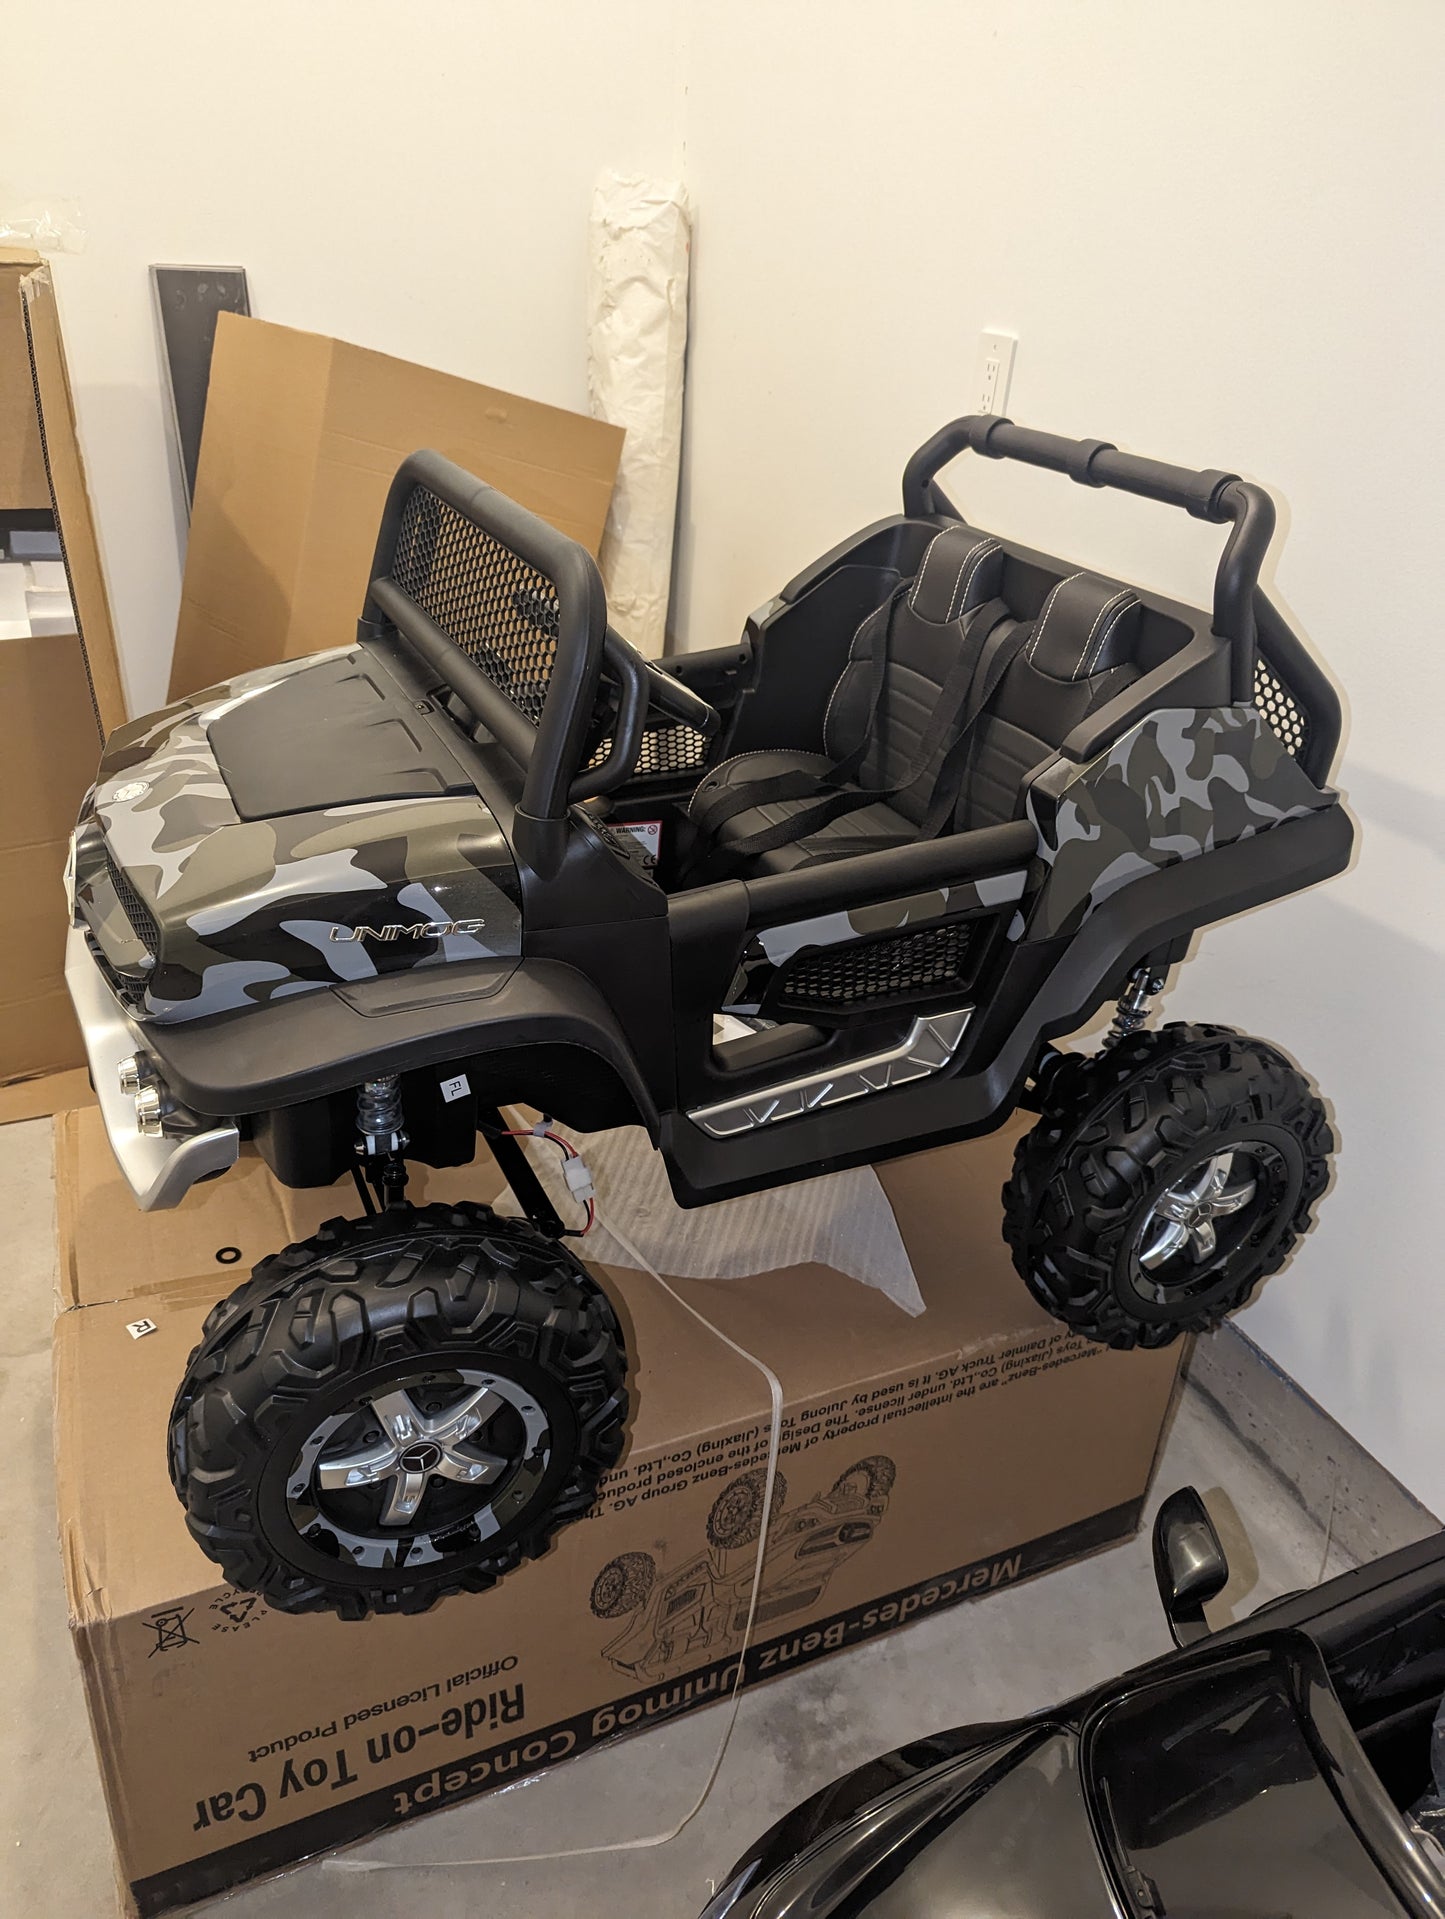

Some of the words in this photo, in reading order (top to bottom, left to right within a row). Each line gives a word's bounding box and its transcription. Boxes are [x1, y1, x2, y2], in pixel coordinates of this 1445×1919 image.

[329, 918, 486, 943] UNIMOG
[448, 1080, 462, 1097] FL
[998, 1338, 1047, 1360] Daimler
[1048, 1334, 1061, 1347] of
[1056, 1340, 1082, 1354] Toys
[961, 1354, 995, 1373] Truck
[1000, 1347, 1053, 1374] (Jiaxing)
[908, 1377, 920, 1388] is
[922, 1374, 931, 1385] It
[935, 1365, 959, 1381] AG.
[950, 1367, 998, 1389] Co.,Ltd.
[871, 1382, 904, 1402] used
[907, 1383, 946, 1401] under
[956, 1385, 976, 1398] the
[979, 1378, 999, 1391] are
[851, 1393, 868, 1406] by
[855, 1395, 905, 1416] license.
[882, 1393, 953, 1424] intellectual
[800, 1400, 848, 1422] Julong
[824, 1413, 849, 1427] The
[763, 1416, 795, 1434] Tos
[778, 1422, 821, 1443] Desig
[823, 1414, 880, 1441] property
[696, 1426, 758, 1457] (Jiaxing)
[728, 1445, 750, 1459] the
[753, 1439, 768, 1453] of
[804, 1436, 818, 1449] of
[633, 1450, 692, 1476] Co.,Ltd.
[656, 1454, 723, 1485] enclosed
[691, 1441, 801, 1483] Meredes-Benz
[596, 1474, 652, 1503] produc
[641, 1479, 688, 1501] Group
[609, 1494, 638, 1512] AG.
[211, 1610, 267, 1632] PLEASE
[758, 1554, 1021, 1670] Mercedes-Benz
[447, 1656, 518, 1692] Official
[343, 1683, 440, 1730] Licensed
[591, 1662, 745, 1737] Unimog
[367, 1683, 524, 1763] Ride-on
[247, 1721, 337, 1763] Product
[280, 1749, 358, 1799] Toy
[394, 1730, 576, 1815] Concept
[193, 1782, 266, 1831] Car
